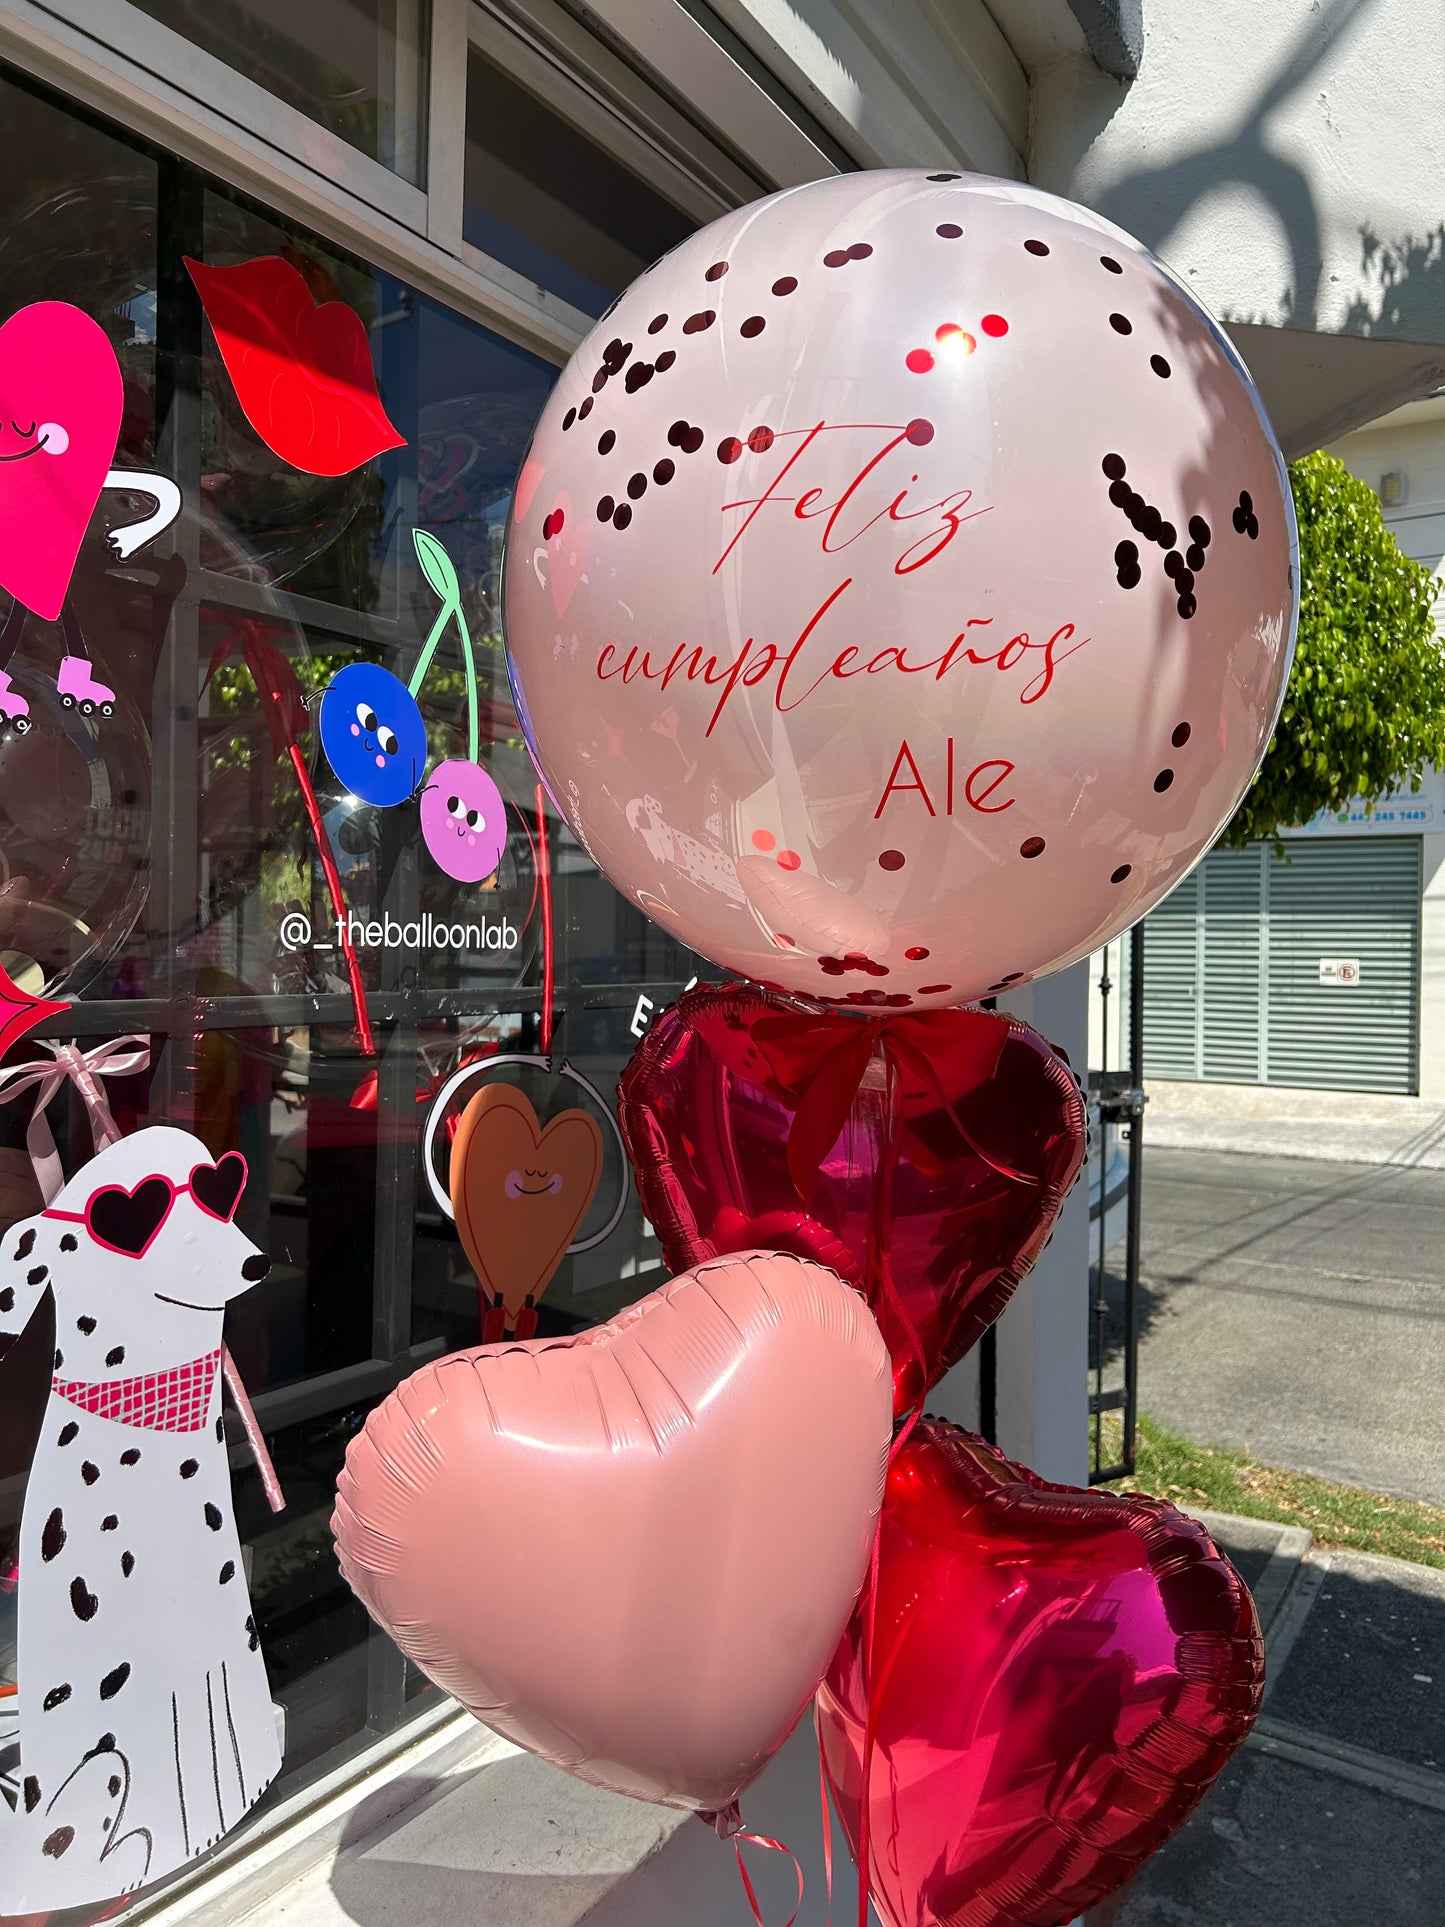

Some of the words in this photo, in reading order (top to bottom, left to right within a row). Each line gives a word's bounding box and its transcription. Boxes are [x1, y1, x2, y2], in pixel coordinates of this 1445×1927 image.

[712, 420, 995, 575] Feliz
[596, 578, 1092, 738] cumpleaños
[873, 737, 1017, 820] Ale
[279, 910, 519, 951] @_theballoonlab
